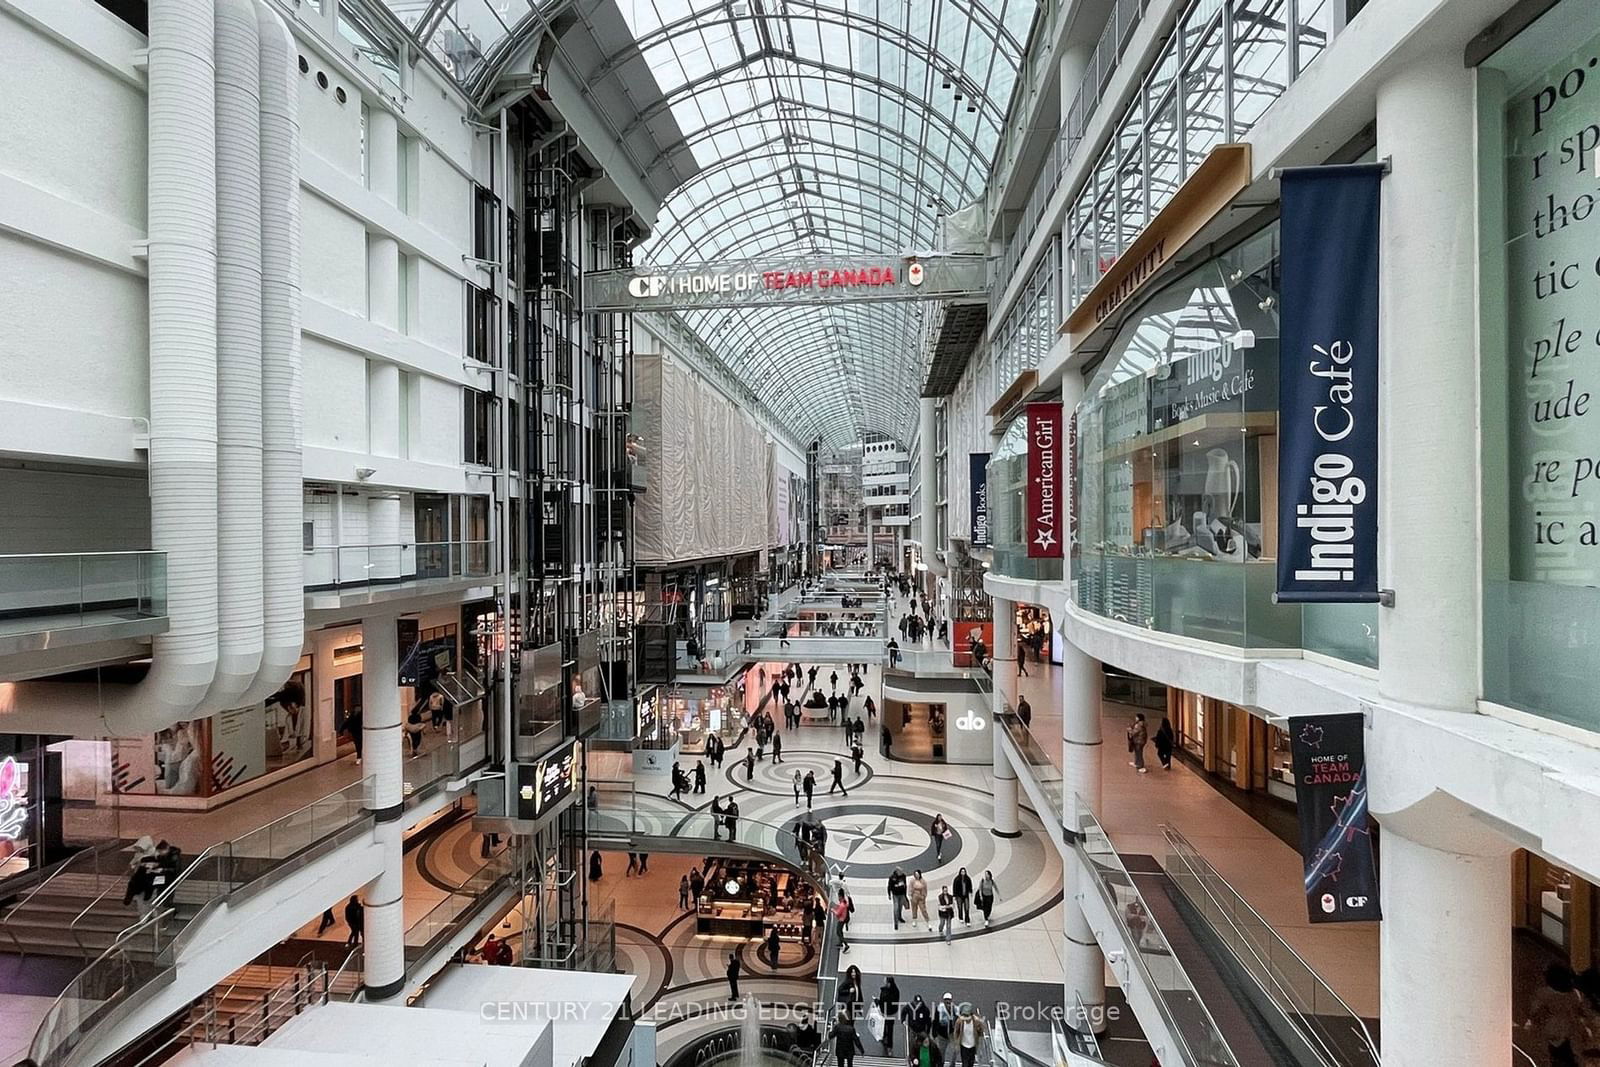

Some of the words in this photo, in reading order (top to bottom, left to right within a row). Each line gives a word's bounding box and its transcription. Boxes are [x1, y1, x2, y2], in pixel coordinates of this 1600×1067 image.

[1532, 57, 1599, 137] po
[1532, 188, 1600, 240] tho
[628, 274, 667, 298] CF
[679, 274, 731, 294] HOME
[734, 273, 759, 291] OF
[762, 271, 813, 290] TEAM
[817, 267, 895, 289] CANADA
[1095, 237, 1166, 323] CREATIVITY
[1532, 260, 1580, 300] tic
[1531, 317, 1583, 378] ple
[1194, 386, 1220, 411] Music
[1221, 382, 1232, 402] &
[1230, 368, 1255, 396] Café
[1309, 340, 1355, 442] Café
[1533, 379, 1591, 423] ude
[1532, 459, 1561, 484] re
[1571, 455, 1600, 498] p
[975, 483, 986, 513] Books
[1295, 453, 1367, 581] Indigo
[973, 515, 988, 544] Indigo
[1535, 511, 1565, 545] ic
[956, 710, 985, 730] alo
[1303, 772, 1361, 785] CANADA
[1311, 755, 1335, 763] HOME
[1337, 754, 1349, 762] OF
[1312, 763, 1350, 773] TEAM
[1346, 896, 1368, 908] CF
